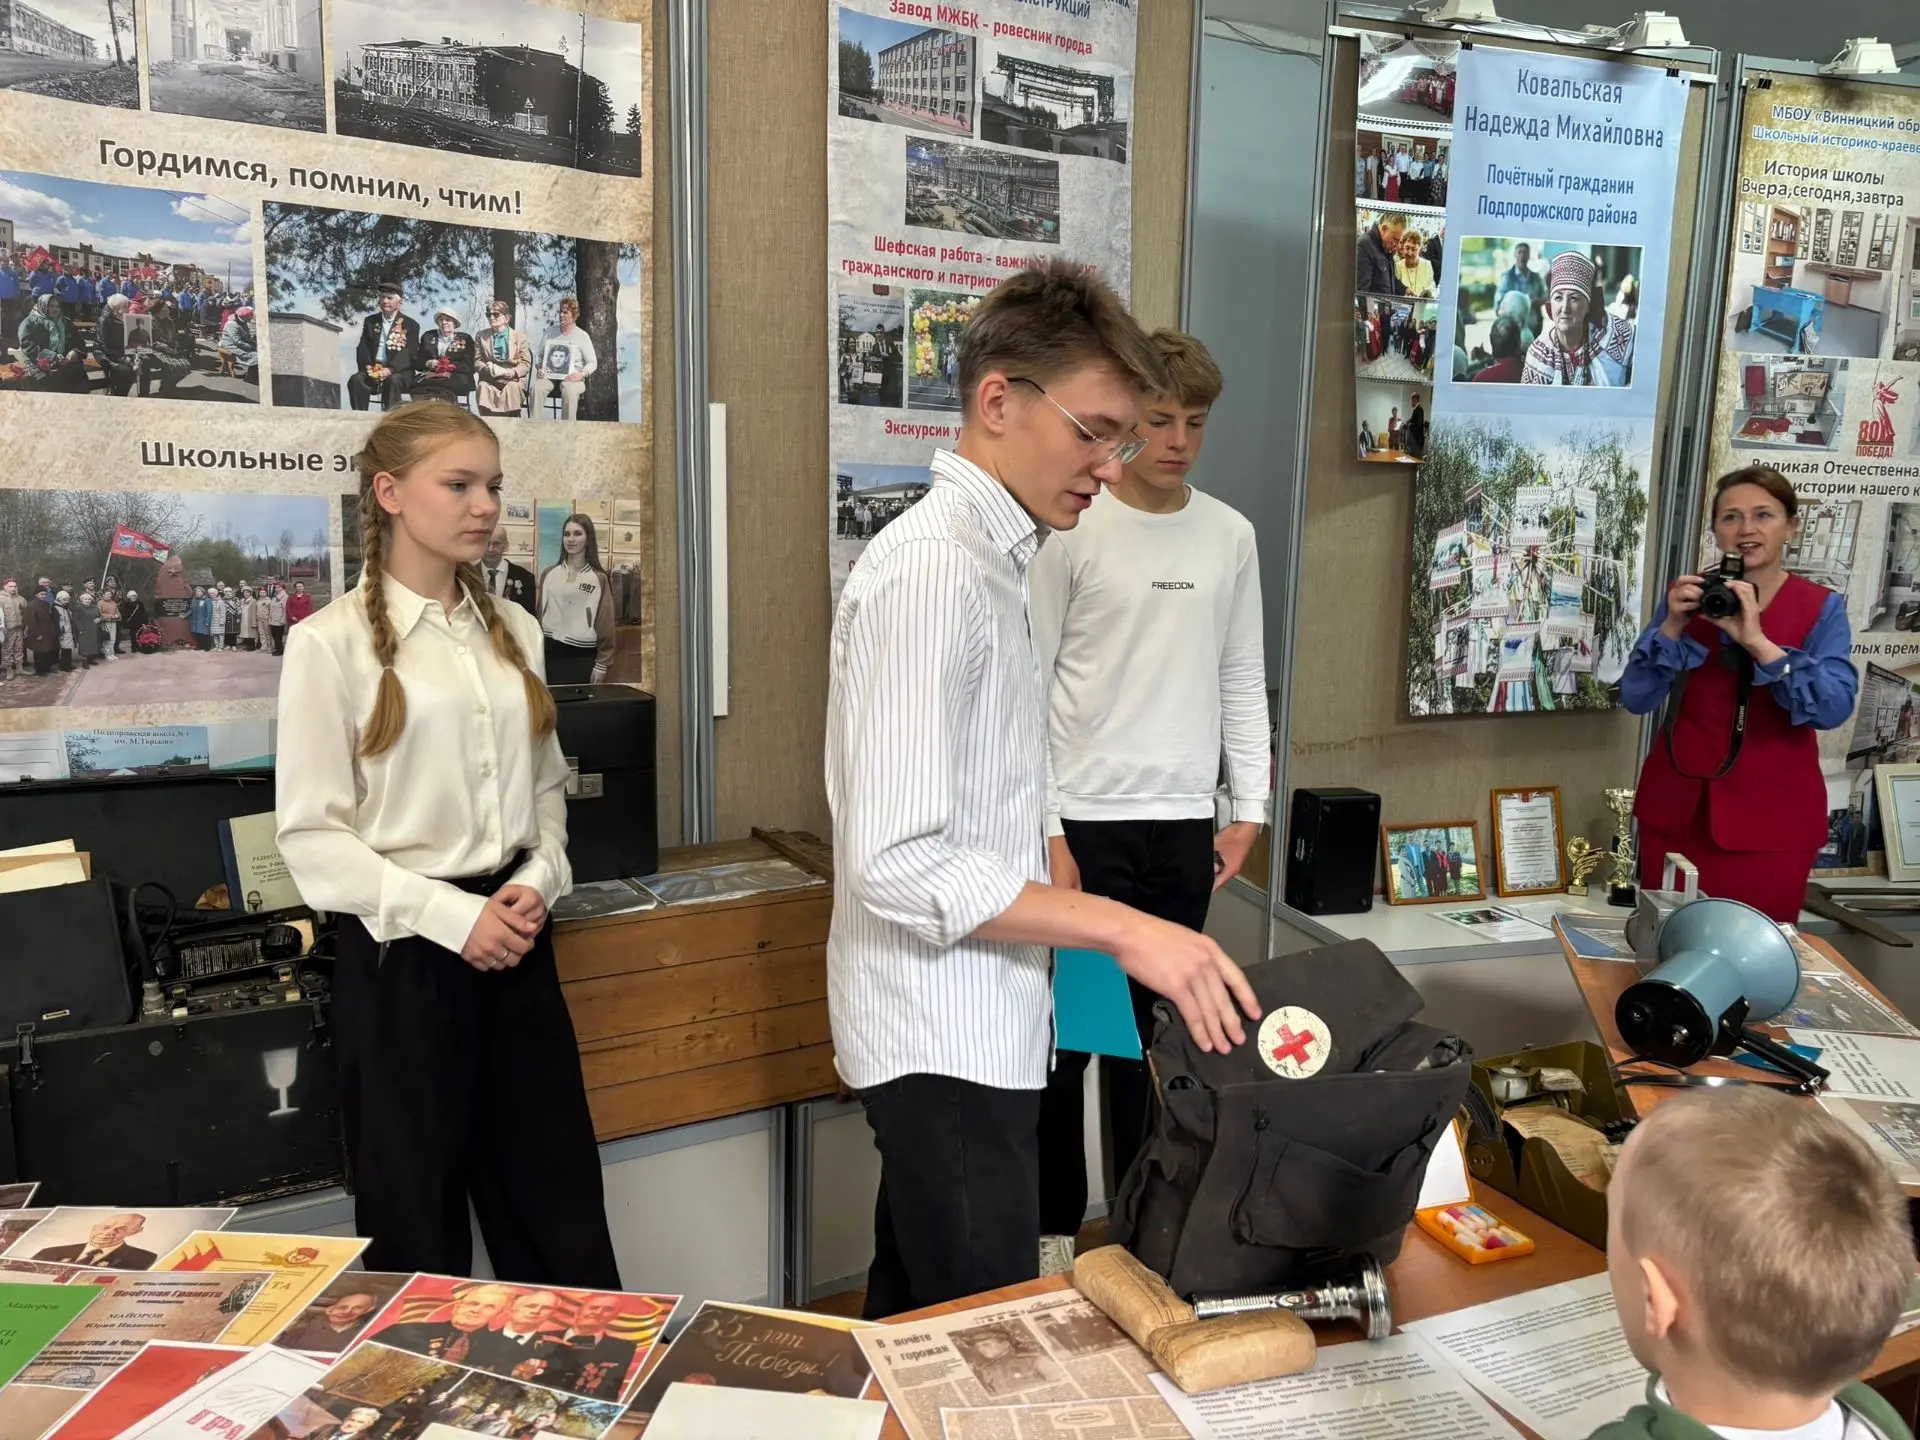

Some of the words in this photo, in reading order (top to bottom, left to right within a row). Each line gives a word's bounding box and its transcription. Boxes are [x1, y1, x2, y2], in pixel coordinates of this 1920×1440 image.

[889, 0, 932, 22] Завод
[936, 5, 979, 30] МЖБК
[993, 21, 1052, 45] ровесник
[1054, 34, 1093, 55] города
[1517, 68, 1622, 104] Ковальская
[1464, 106, 1550, 141] Надежда
[1556, 114, 1664, 148] Михайловна
[1772, 105, 1812, 122] МБОУ
[1815, 111, 1895, 130] «Винницкий
[1752, 125, 1819, 144] Школьный
[98, 139, 280, 190] Гордимся,
[289, 168, 431, 209] помним,
[437, 188, 523, 215] чтим!
[1486, 163, 1554, 189] Почётный
[1558, 173, 1635, 195] гражданин
[1764, 160, 1828, 181] История
[1833, 171, 1885, 185] школы
[1477, 194, 1584, 223] Подпорожского
[1587, 204, 1638, 227] района
[874, 236, 936, 258] Шефская
[940, 247, 983, 264] работа
[842, 258, 934, 281] гражданского
[938, 272, 945, 283] и
[885, 419, 950, 440] Экскурсии
[141, 441, 324, 472] Школьные
[1856, 445, 1894, 459] ПОБЕДА!
[1793, 482, 1856, 496] истории
[1859, 485, 1910, 497] нашего
[578, 582, 597, 595] 1987
[1151, 581, 1194, 590] FREEDOM
[1850, 643, 1881, 655] лых
[1884, 645, 1920, 658] врем
[875, 1338, 886, 1349] В
[893, 1332, 932, 1347] почёте
[714, 1340, 841, 1379] Победы!
[884, 1354, 892, 1366] у
[900, 1344, 950, 1362] горожан
